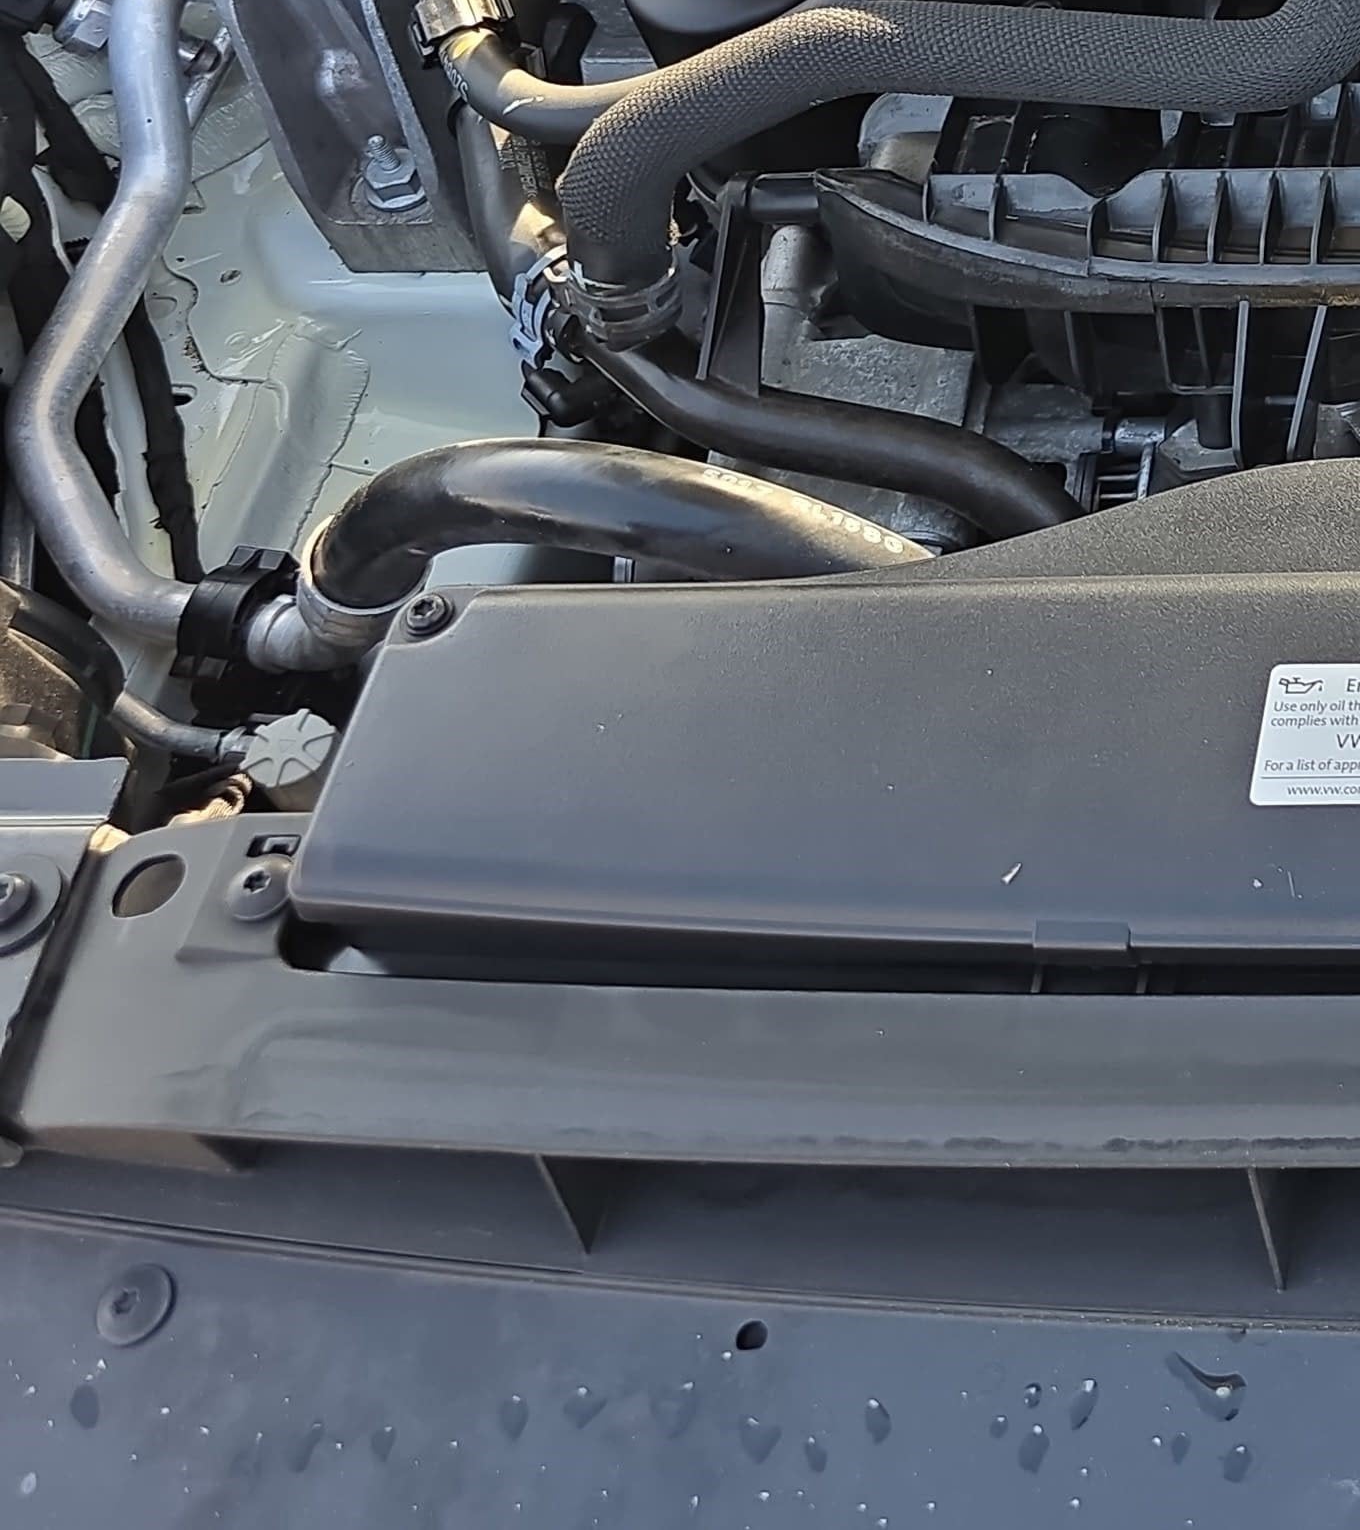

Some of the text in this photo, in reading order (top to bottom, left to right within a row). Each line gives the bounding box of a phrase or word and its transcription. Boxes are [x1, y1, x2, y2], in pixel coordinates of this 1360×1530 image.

[1272, 700, 1298, 711] Use
[1298, 700, 1327, 714] only
[1328, 699, 1346, 711] oil
[1269, 714, 1359, 729] complies with
[1263, 759, 1284, 771] For
[1285, 762, 1294, 771] a
[1296, 759, 1316, 771] list
[1316, 758, 1332, 770] of
